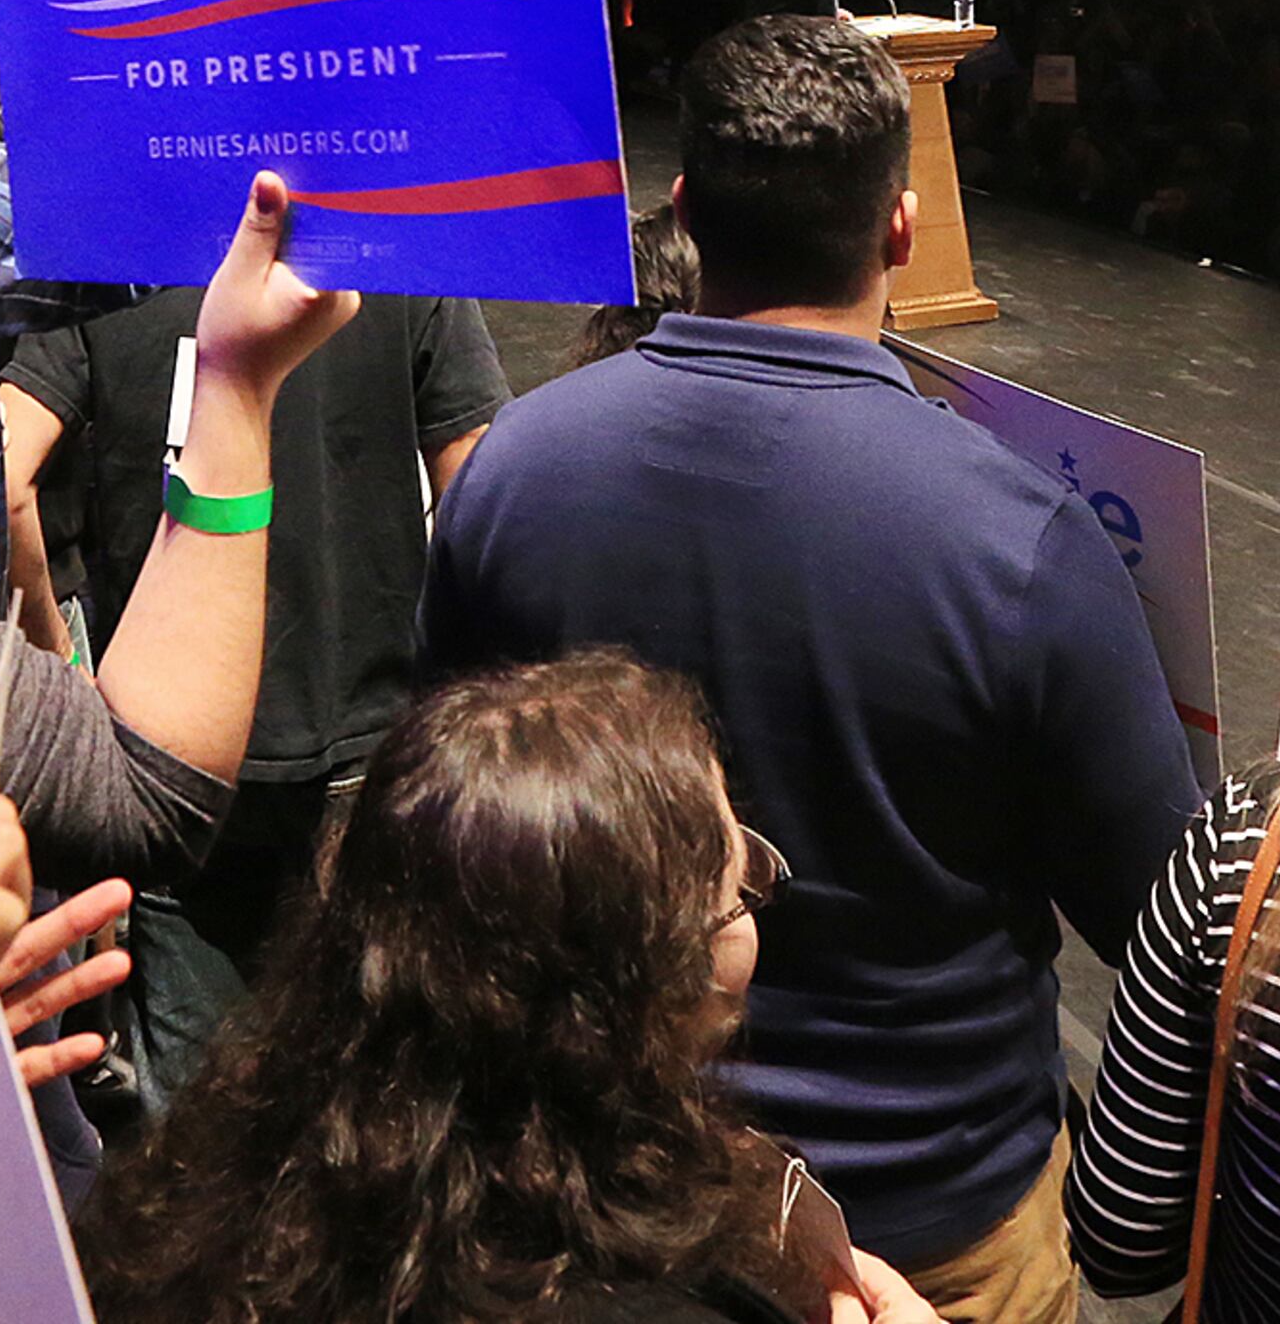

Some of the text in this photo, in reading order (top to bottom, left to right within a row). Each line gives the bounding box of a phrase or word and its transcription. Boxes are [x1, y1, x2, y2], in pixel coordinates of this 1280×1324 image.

[124, 43, 423, 90] FOR PRESIDENT
[147, 128, 411, 160] BERNIESANDERS.COM
